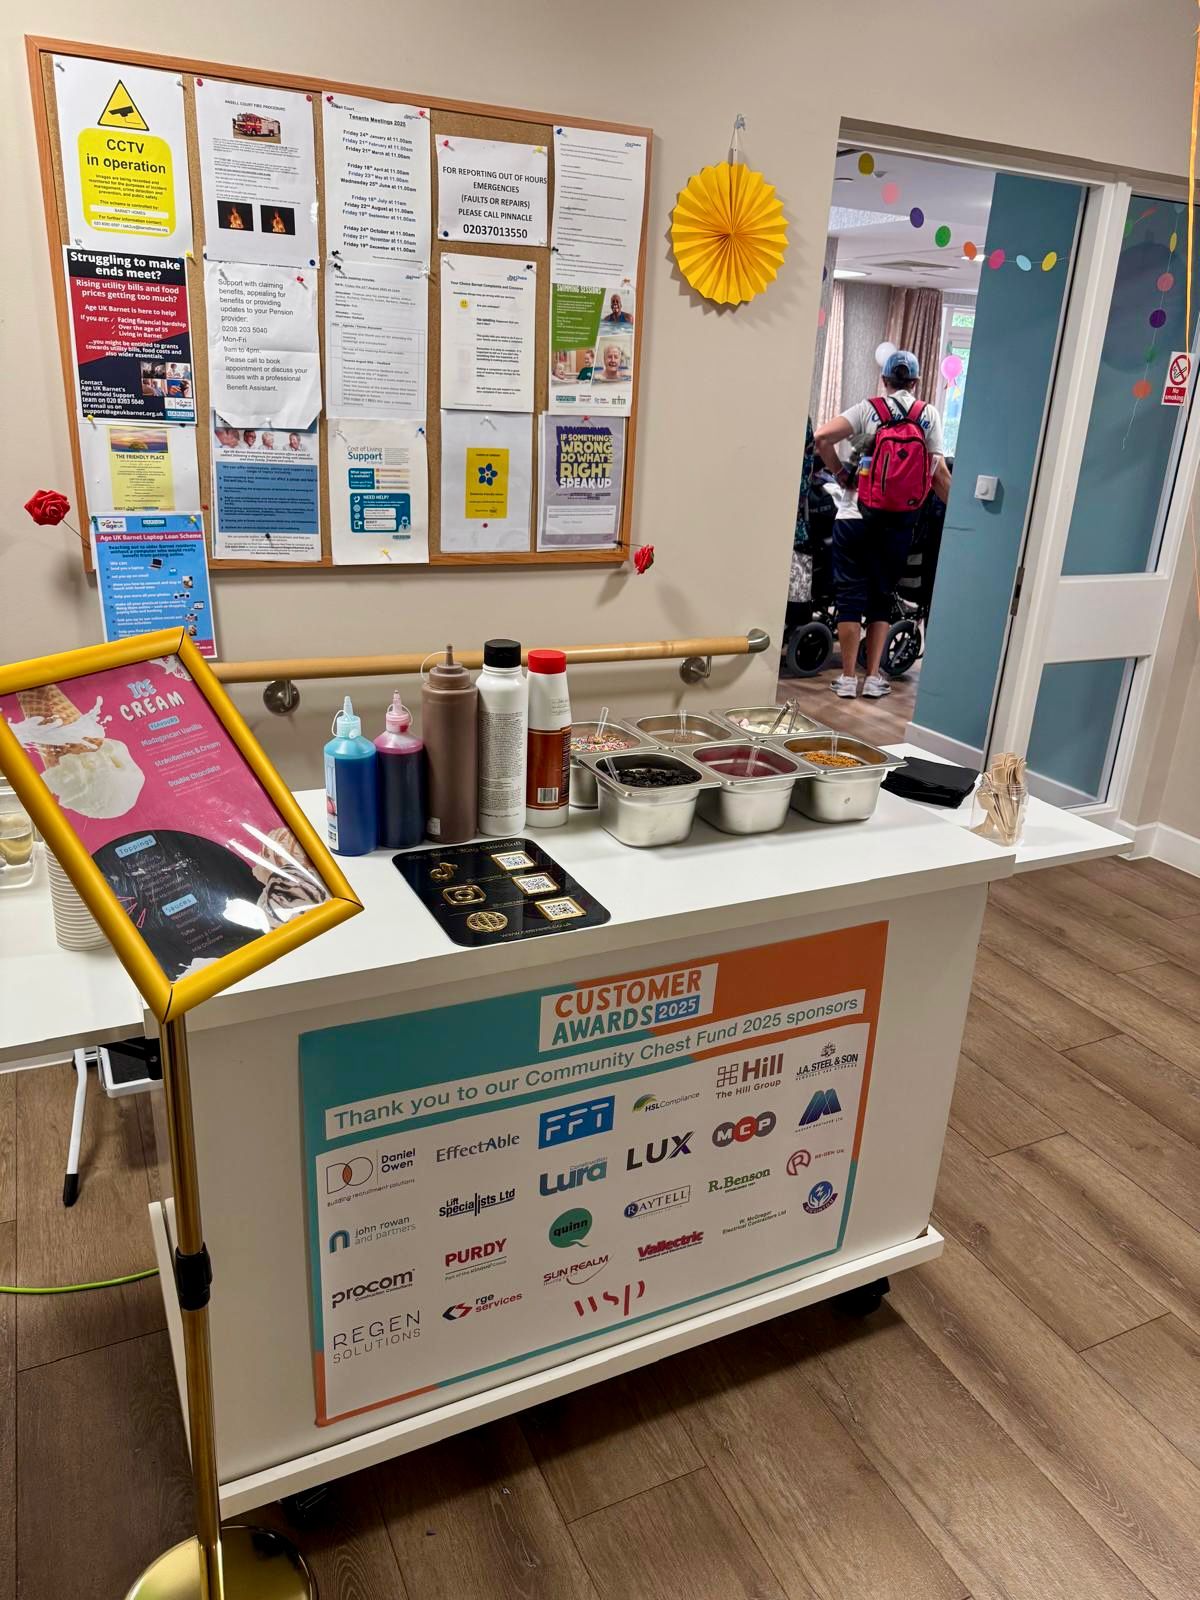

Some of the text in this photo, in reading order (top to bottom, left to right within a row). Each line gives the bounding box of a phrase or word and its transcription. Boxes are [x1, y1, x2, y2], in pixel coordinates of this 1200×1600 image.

[106, 138, 145, 154] CCTV
[86, 153, 166, 174] in operation
[443, 166, 547, 184] FOR REPORTING OUT OF HOURS
[474, 182, 520, 193] EMERGENCIES
[461, 194, 530, 209] (FAULTS OR REPAIRS)
[458, 208, 532, 222] PLEASE CALL PINNACLE
[463, 224, 528, 238] 02037013550
[70, 251, 180, 270] Struggling to make
[96, 266, 162, 280] ends meet?
[76, 279, 180, 294] Rising utility bills and food
[218, 279, 242, 288] Support
[258, 281, 284, 290] claiming
[82, 289, 106, 298] prices
[107, 291, 136, 301] getting
[152, 294, 178, 303] much?
[219, 288, 246, 296] benefits,
[246, 290, 276, 298] appealing
[85, 304, 97, 312] Age
[108, 305, 130, 313] Barnet
[131, 306, 136, 314] is
[138, 307, 152, 315] here
[162, 309, 176, 317] help!
[254, 298, 282, 307] providing
[220, 306, 246, 314] updates
[269, 308, 294, 316] Pension
[246, 356, 258, 364] call
[226, 366, 262, 374] appointment
[271, 366, 294, 374] discuss
[266, 374, 301, 382] professional
[561, 441, 613, 454] WRONG
[348, 452, 382, 462] Support
[560, 453, 614, 463] DO WHAT'S
[560, 462, 613, 478] RIGHT
[560, 478, 612, 489] SPEAK UP
[144, 534, 164, 542] Laptop
[128, 678, 157, 699] ICE
[120, 690, 184, 721] CREAM
[119, 838, 154, 854] Toppings
[555, 969, 702, 1018] CUSTOMER
[552, 998, 696, 1046] AWARDS 2025
[334, 997, 858, 1129] Thank you to our Community Chest Fund 2025 sponsors
[742, 1053, 784, 1082] Hill
[811, 1058, 833, 1072] STEEL
[834, 1056, 840, 1066] &
[841, 1053, 858, 1064] SON
[716, 1080, 782, 1100] The Hill Group
[546, 1102, 610, 1141] FFT
[382, 1148, 416, 1164] Daniel
[436, 1133, 520, 1163] EffectAble
[626, 1130, 696, 1171] LUX
[382, 1159, 414, 1174] Owen
[540, 1161, 608, 1196] Lura
[708, 1168, 770, 1192] R.Benson
[439, 1188, 516, 1218] Specialists Ltd
[446, 1197, 459, 1207] Lift
[624, 1190, 687, 1216] RAYTELL
[354, 1216, 410, 1239] john rowan
[354, 1224, 416, 1246] and partners
[554, 1220, 588, 1237] quinn
[444, 1238, 508, 1268] PURDY
[543, 1254, 609, 1282] SUN REALM
[332, 1270, 413, 1310] procom
[475, 1294, 494, 1306] rge
[475, 1292, 523, 1313] services
[333, 1310, 420, 1350] REGEN
[333, 1328, 420, 1364] SOLUTIONS
